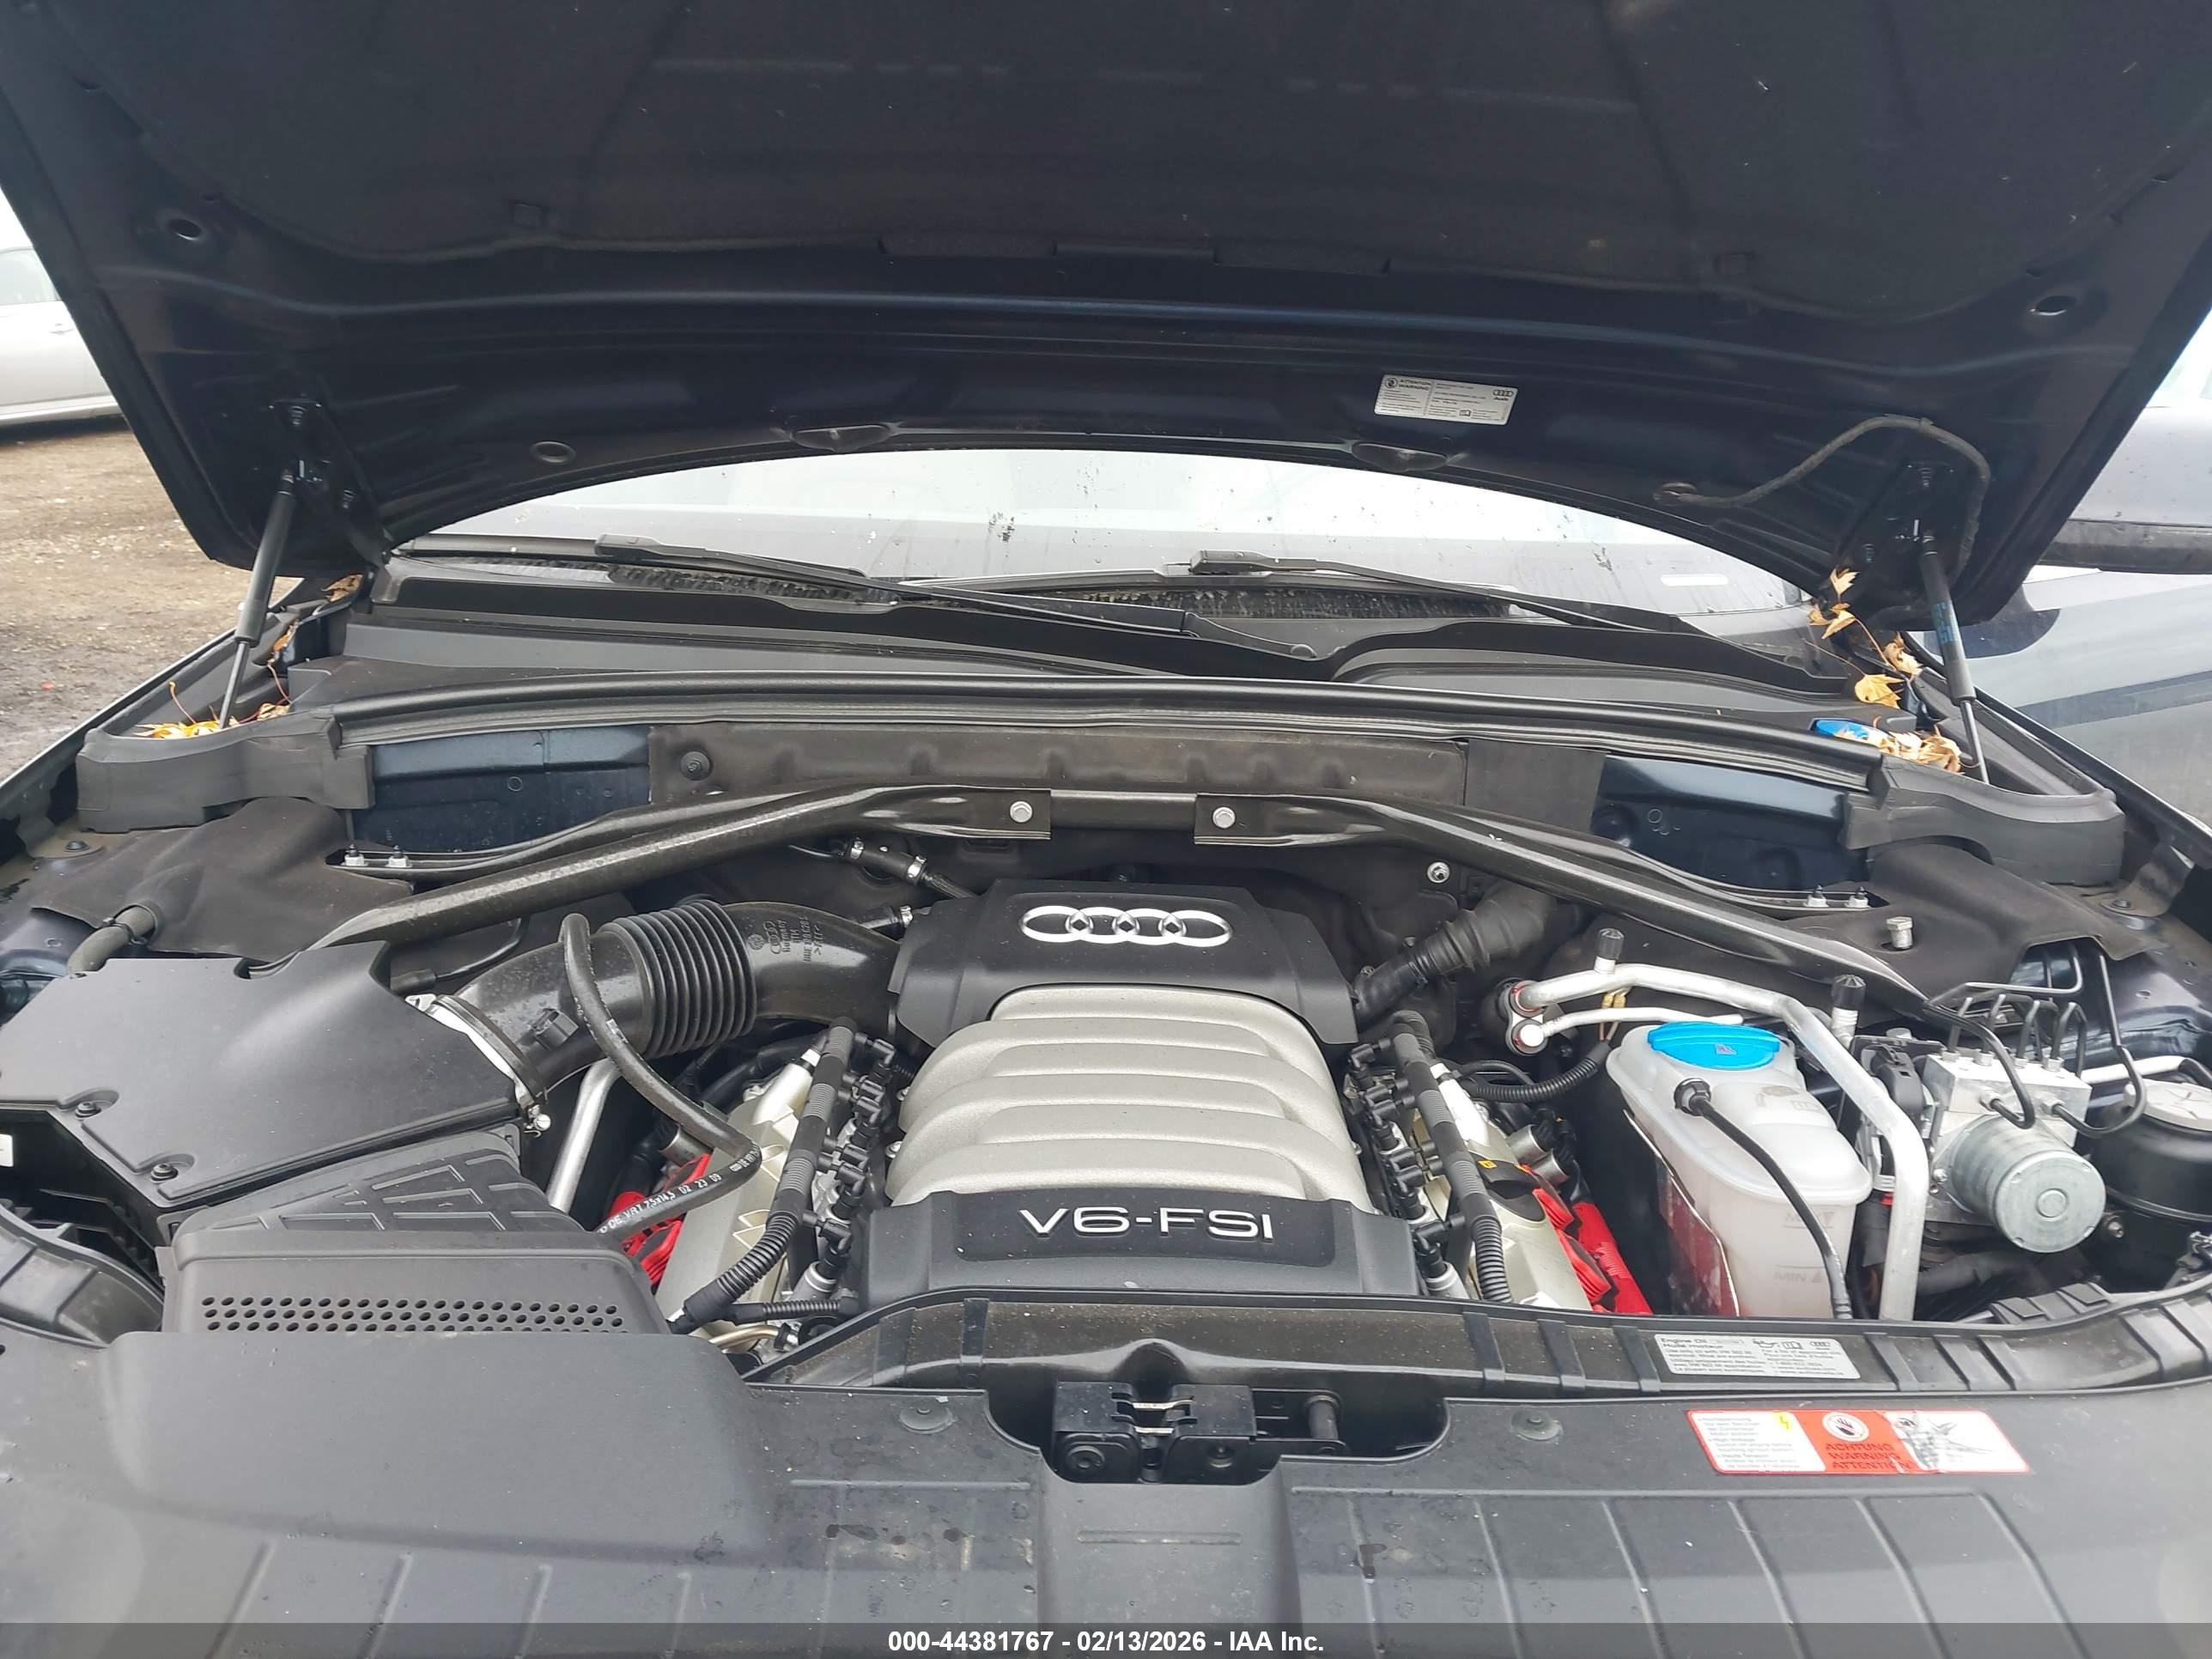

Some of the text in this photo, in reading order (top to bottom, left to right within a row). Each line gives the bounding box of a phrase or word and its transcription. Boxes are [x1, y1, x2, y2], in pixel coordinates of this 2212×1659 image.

[624, 1202, 644, 1218] VRT
[679, 1184, 692, 1195] 02
[695, 1178, 708, 1189] 23
[710, 1173, 722, 1183] 09
[1018, 1206, 1273, 1243] V6-FSI
